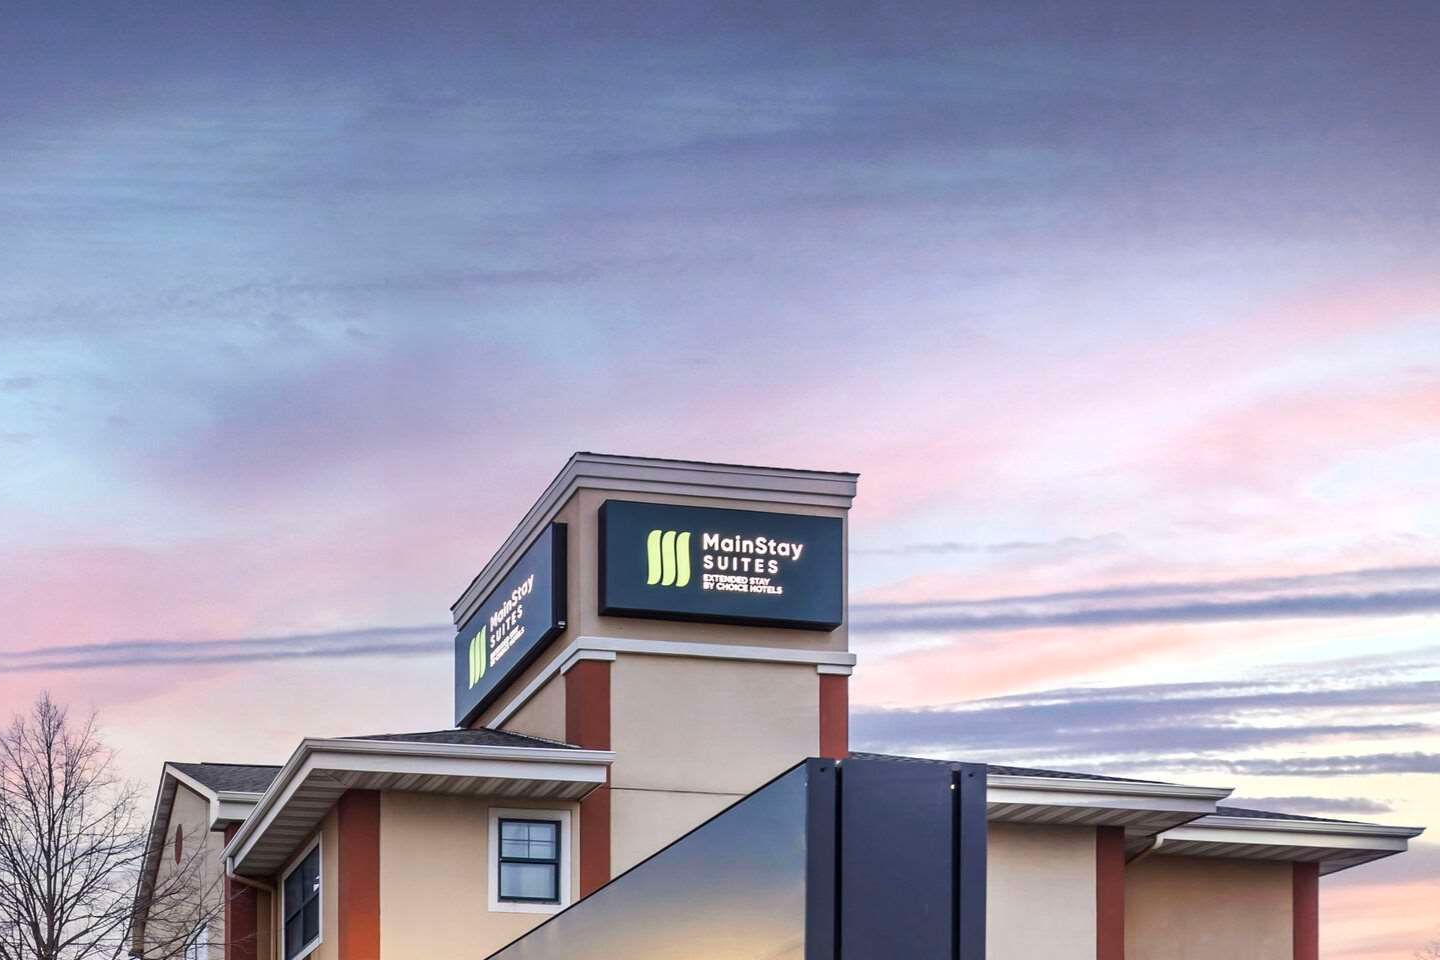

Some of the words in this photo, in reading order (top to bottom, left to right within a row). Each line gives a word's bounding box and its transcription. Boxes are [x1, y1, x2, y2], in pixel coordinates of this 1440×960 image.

[703, 533, 803, 561] MainStay
[703, 555, 778, 574] SUITES
[703, 574, 748, 584] EXTENDED
[750, 577, 771, 586] STAY
[703, 581, 714, 590] BY
[716, 582, 748, 592] CHOICE
[750, 585, 782, 594] HOTELS
[490, 574, 534, 632] MainStay
[490, 605, 523, 648] SUITES
